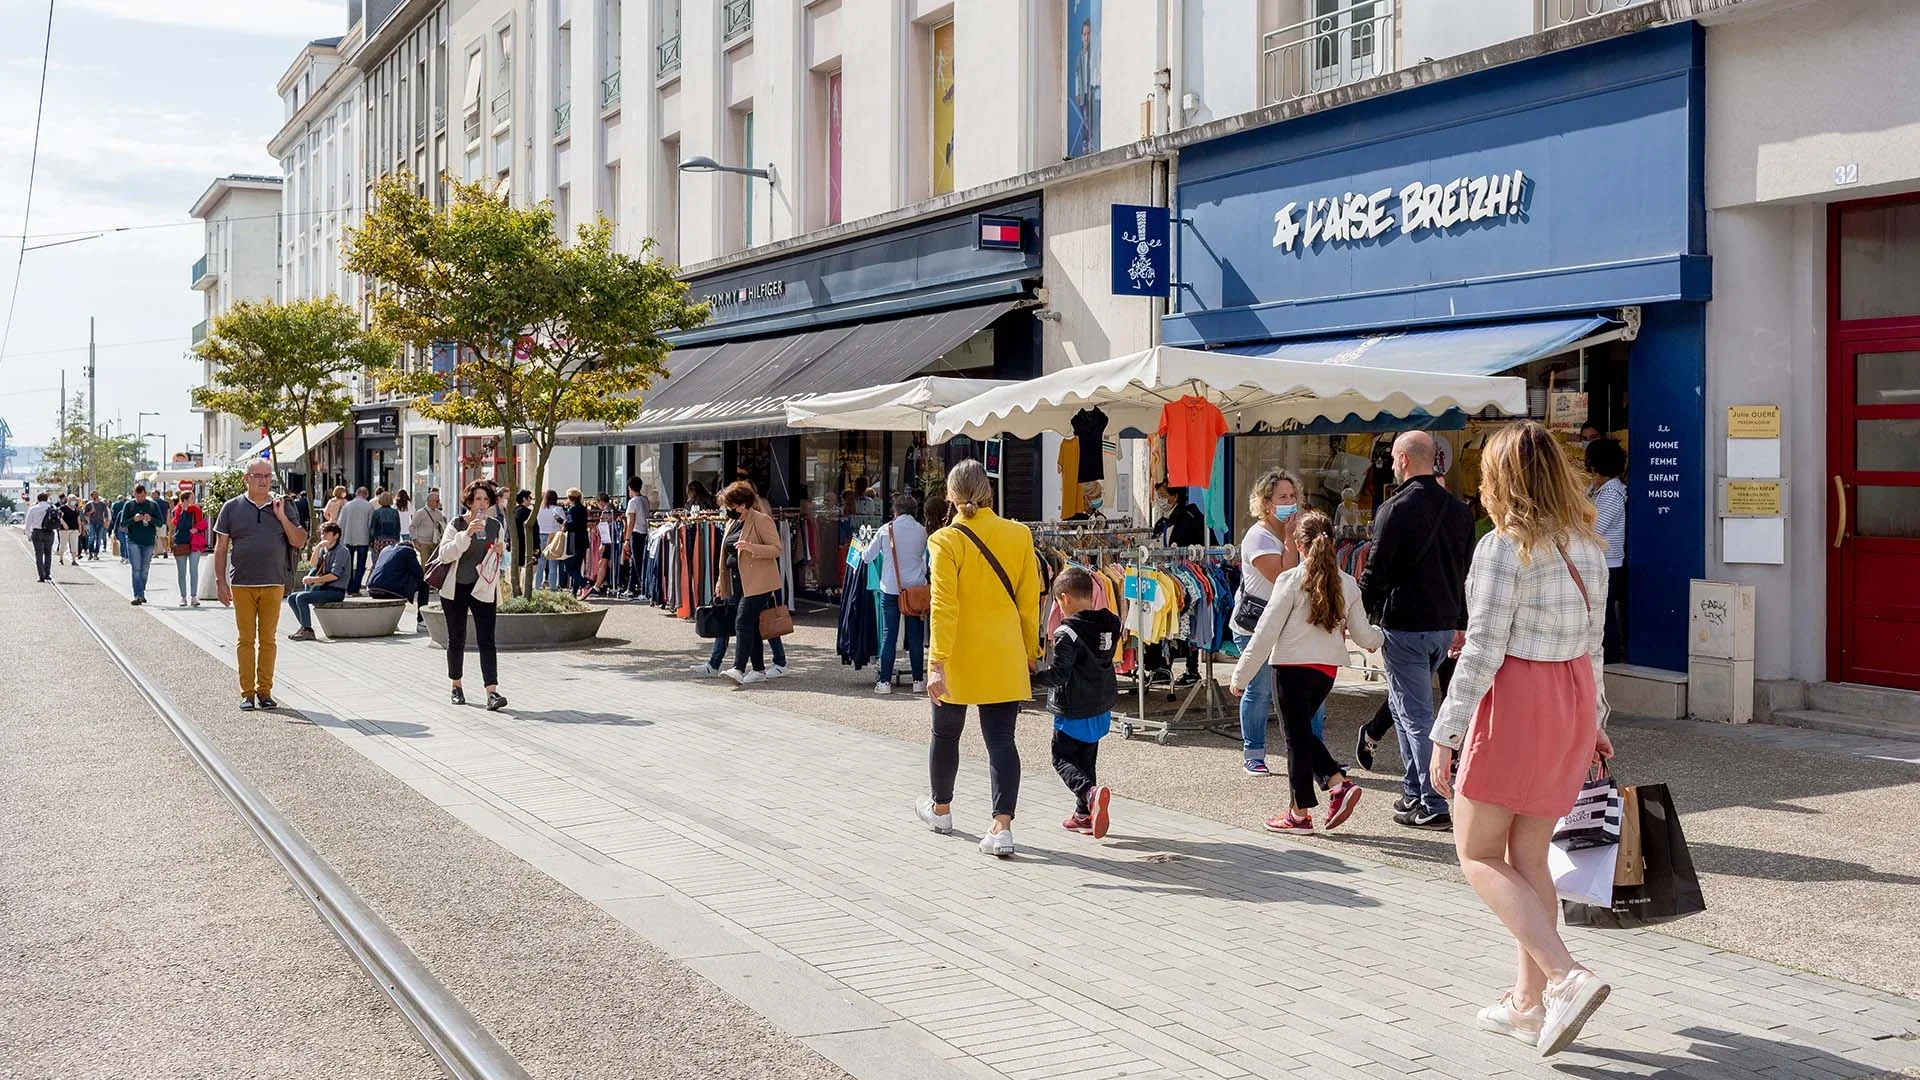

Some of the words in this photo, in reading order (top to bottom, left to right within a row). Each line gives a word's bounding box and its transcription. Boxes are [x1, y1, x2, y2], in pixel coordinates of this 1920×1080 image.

[1835, 164, 1858, 185] 32
[748, 280, 784, 300] HILFIGER
[1649, 441, 1679, 449] HOMME
[1650, 457, 1679, 466] FEMME
[1648, 473, 1681, 482] ENFANT
[1648, 490, 1680, 498] MAISON
